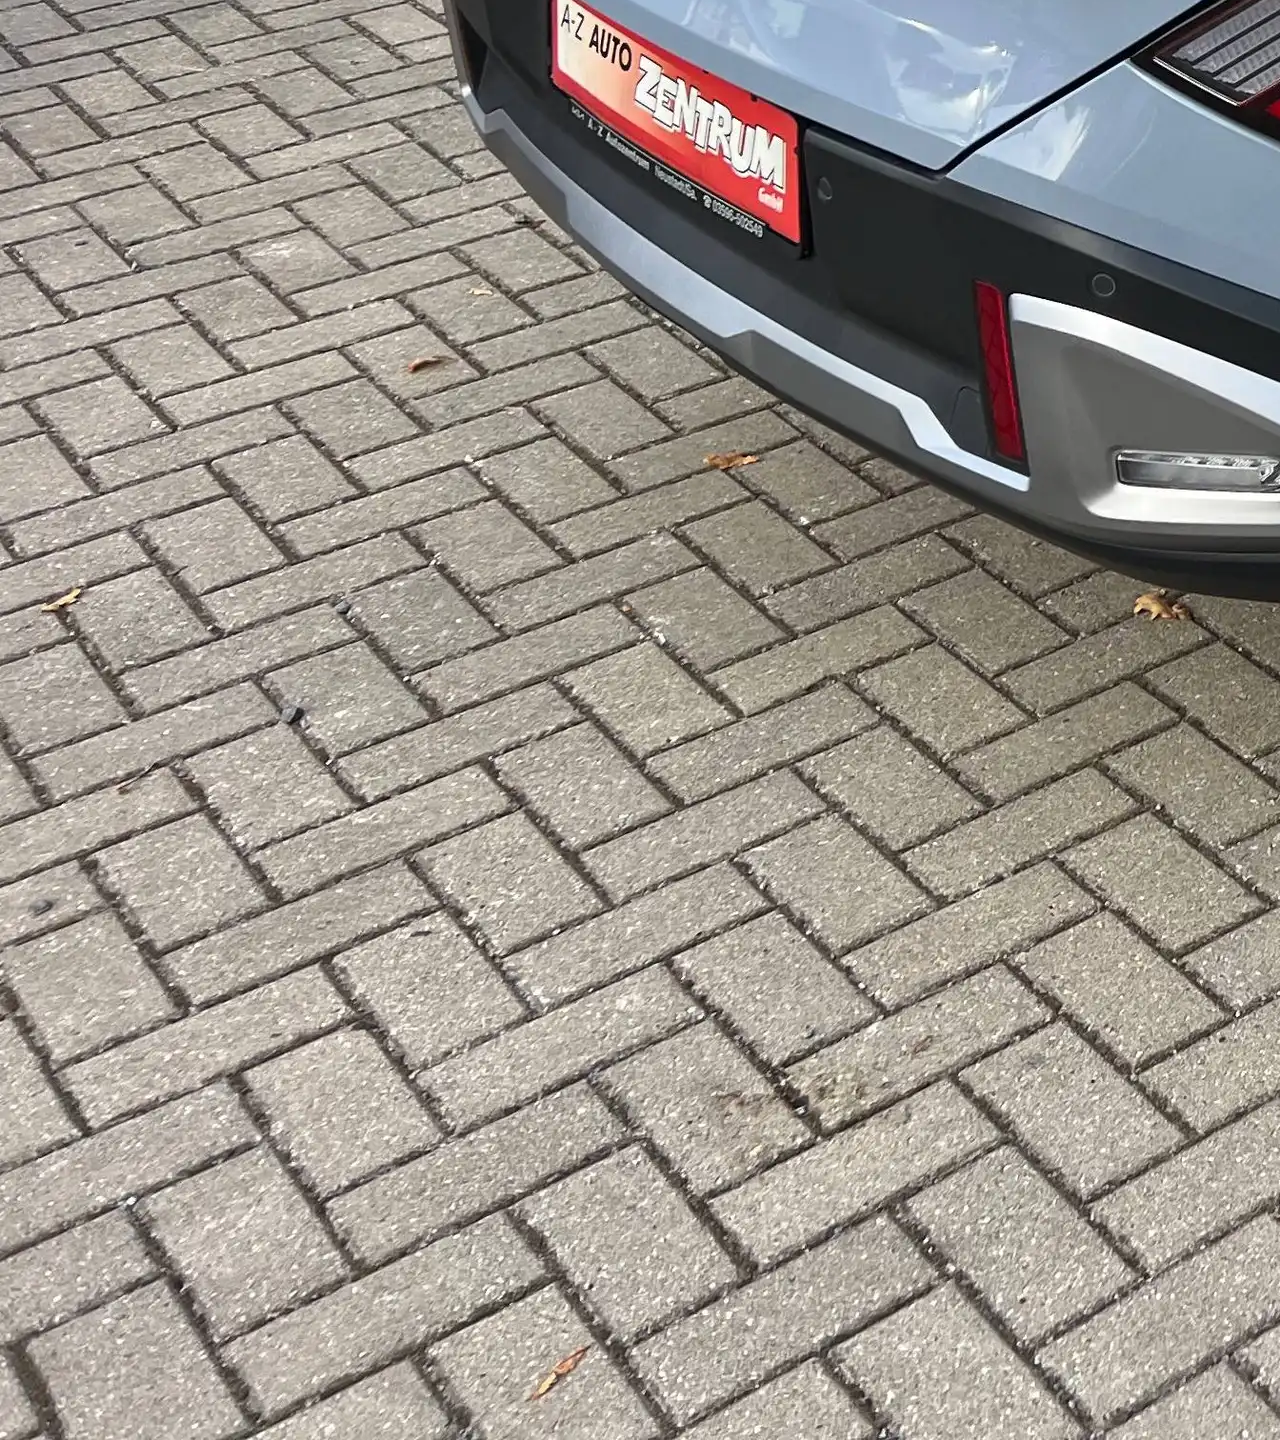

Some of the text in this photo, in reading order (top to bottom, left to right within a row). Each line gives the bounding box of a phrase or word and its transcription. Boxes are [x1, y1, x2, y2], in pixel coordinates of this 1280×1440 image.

[561, 4, 787, 194] A-Z AUTO ZENTRUM
